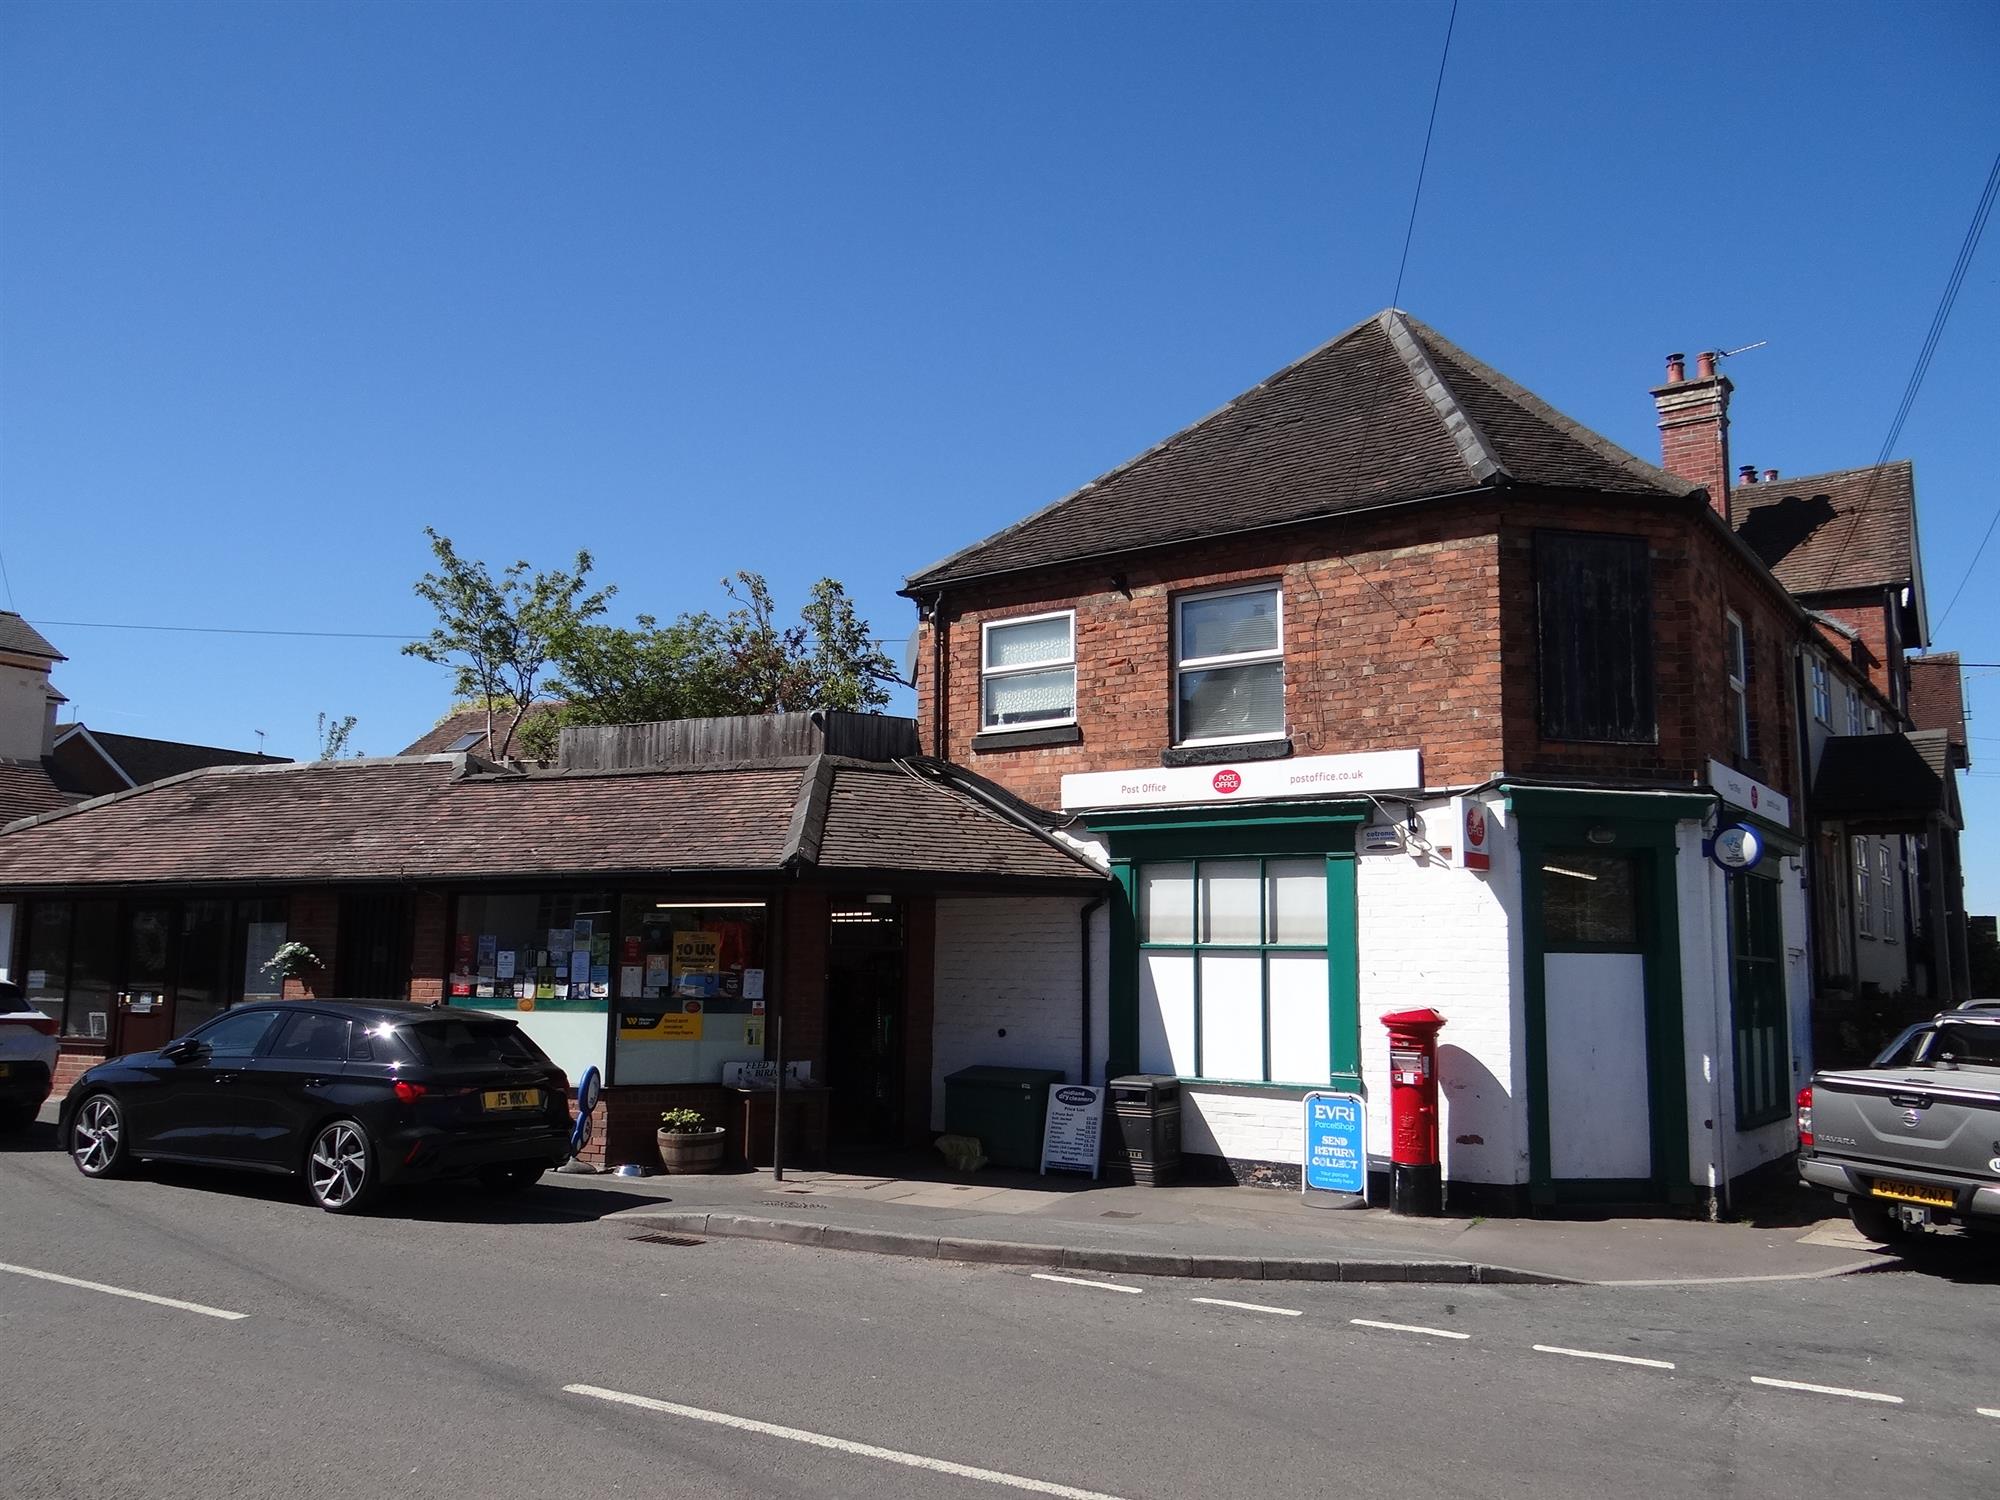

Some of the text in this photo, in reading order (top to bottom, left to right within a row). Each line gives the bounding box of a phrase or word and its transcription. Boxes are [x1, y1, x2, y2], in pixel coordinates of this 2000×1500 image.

[1218, 772, 1236, 781] POST
[1290, 769, 1363, 784] postoffice.co.uk
[1121, 782, 1167, 794] Post Office
[1214, 779, 1239, 789] OFFICE
[695, 943, 716, 955] UK
[746, 1061, 770, 1070] FEED
[1058, 1093, 1069, 1102] dry
[1314, 1104, 1356, 1121] EVRi
[1314, 1120, 1356, 1132] ParcelShop
[1322, 1136, 1348, 1146] SEND
[1818, 1133, 1857, 1146] NAVARA
[1314, 1146, 1355, 1158] RETURN
[1312, 1156, 1358, 1169] COLLECT
